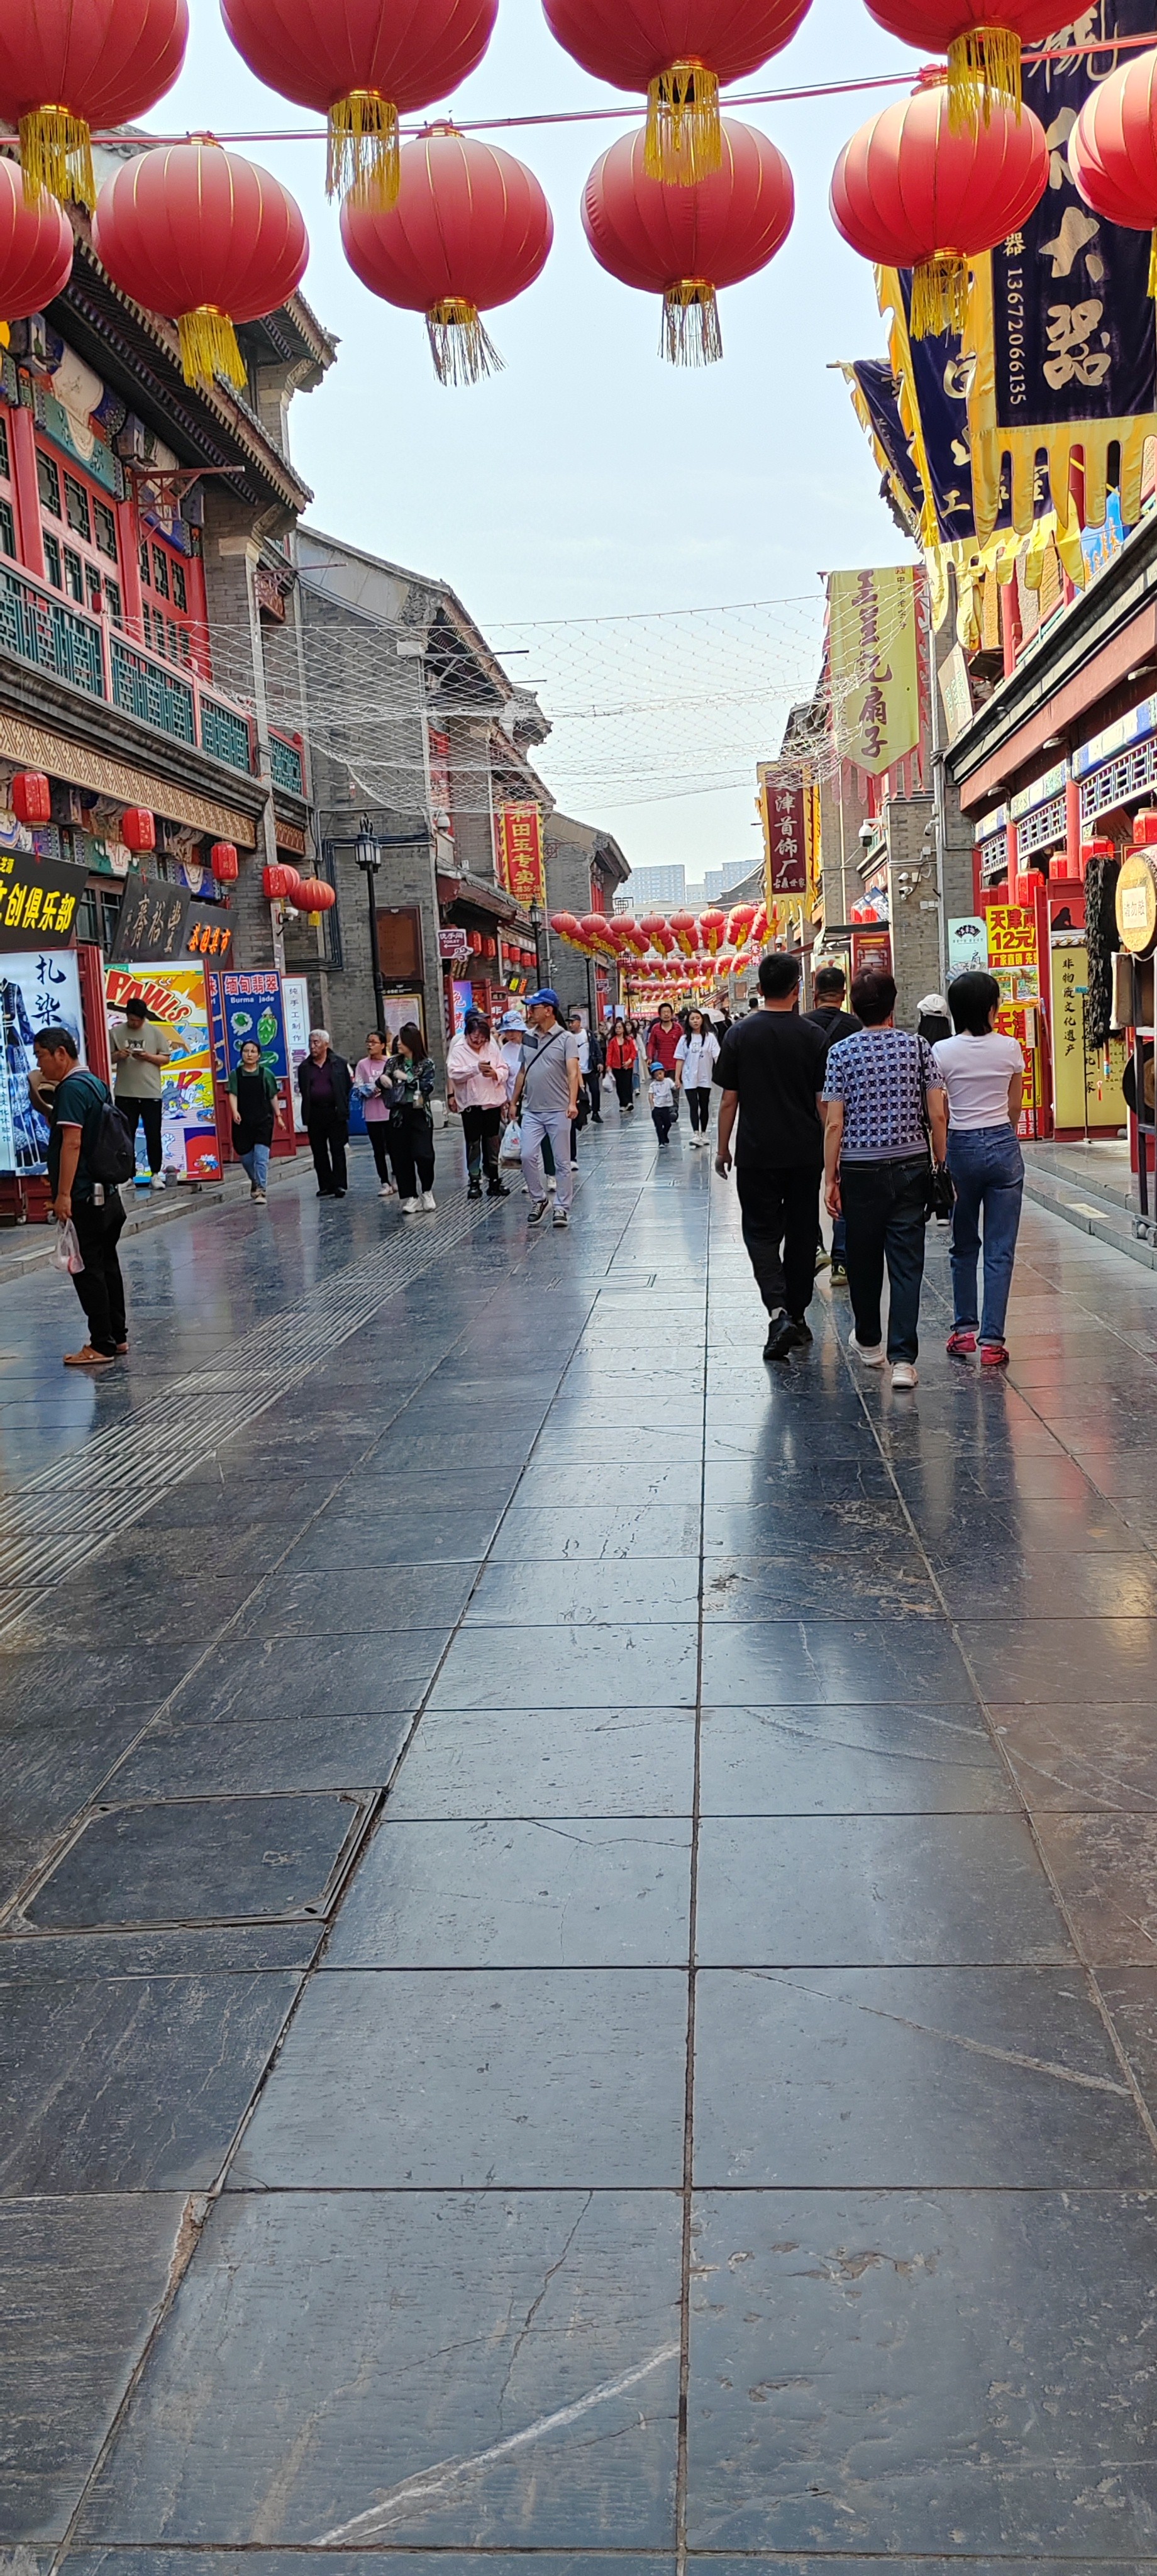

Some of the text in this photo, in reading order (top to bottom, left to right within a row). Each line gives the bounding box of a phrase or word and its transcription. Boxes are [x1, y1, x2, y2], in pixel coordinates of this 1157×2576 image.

[1007, 267, 1027, 404] 13672066135
[31, 954, 67, 1026] 扎染
[224, 974, 279, 995] 缅甸翡翠
[1062, 957, 1077, 1056] 非物质文化遗产
